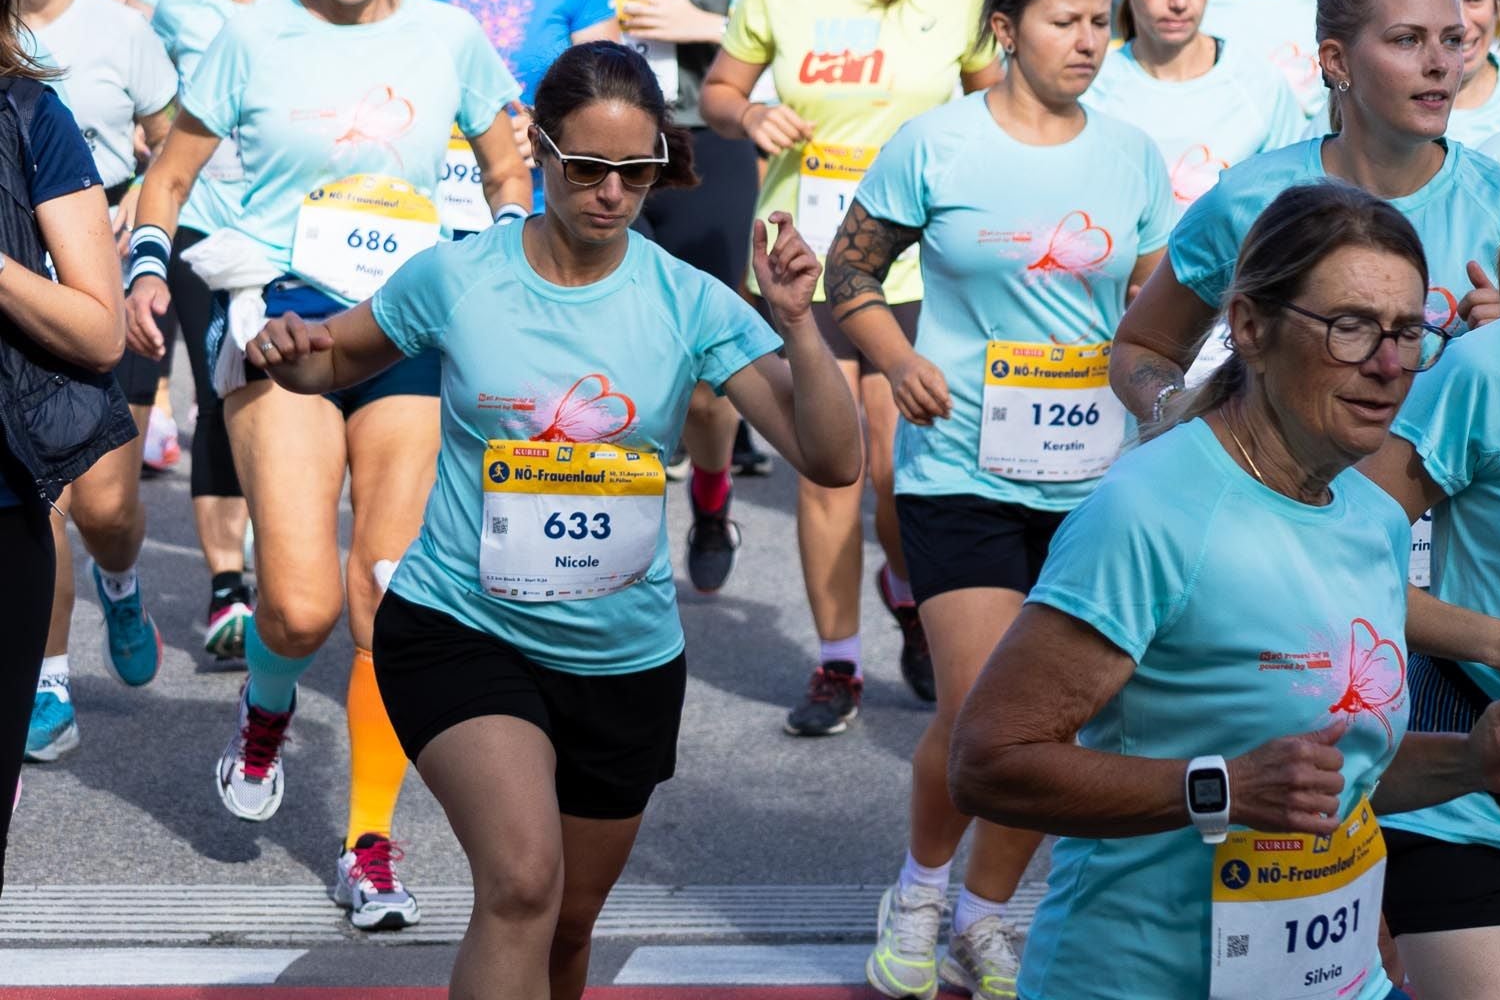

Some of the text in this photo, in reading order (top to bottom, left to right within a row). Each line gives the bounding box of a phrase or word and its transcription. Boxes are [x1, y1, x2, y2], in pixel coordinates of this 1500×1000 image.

[799, 49, 884, 84] can
[347, 228, 397, 253] 686
[1014, 364, 1089, 378] NÖ-Frauenlauf
[1032, 402, 1099, 426] 1266
[514, 448, 548, 457] KURIER
[1043, 439, 1085, 451] Kerstin
[514, 464, 606, 483] NÖ-Frauenlauf
[544, 512, 611, 540] 633
[555, 555, 600, 568] Nicole
[1255, 841, 1302, 850] KURIER
[1257, 849, 1356, 883] NÖ-Frauenlauf
[1285, 898, 1360, 954] 1031
[1304, 964, 1343, 986] Silvia
